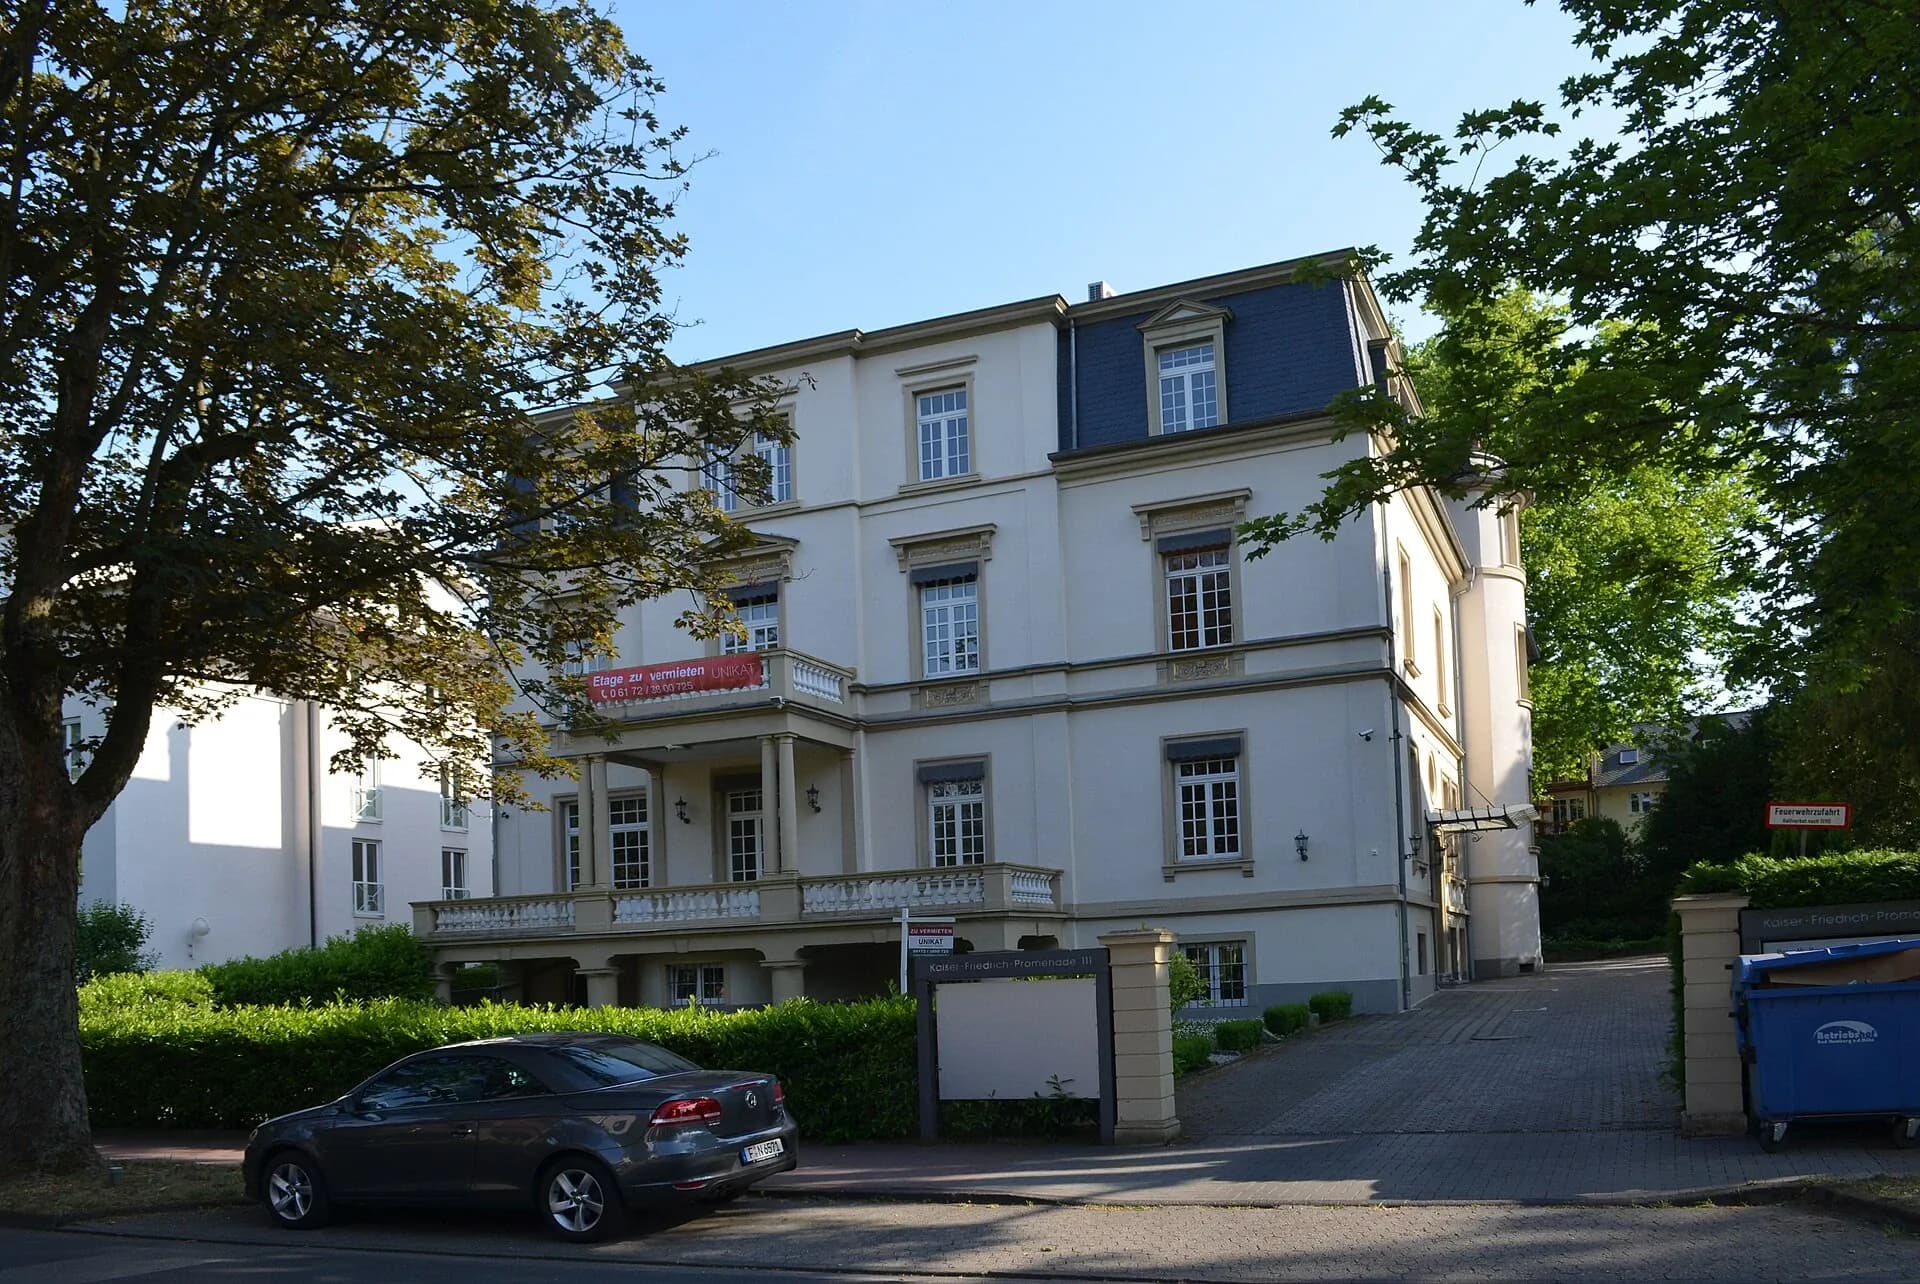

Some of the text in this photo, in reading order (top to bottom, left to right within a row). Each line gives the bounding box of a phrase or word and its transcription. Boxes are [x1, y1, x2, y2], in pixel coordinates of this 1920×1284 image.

[593, 663, 755, 688] Etage zu vermieten UNIKAT
[610, 681, 694, 698] 0 61 72 / 38 00 725
[1775, 807, 1840, 816] Feuerwehrzufahrt
